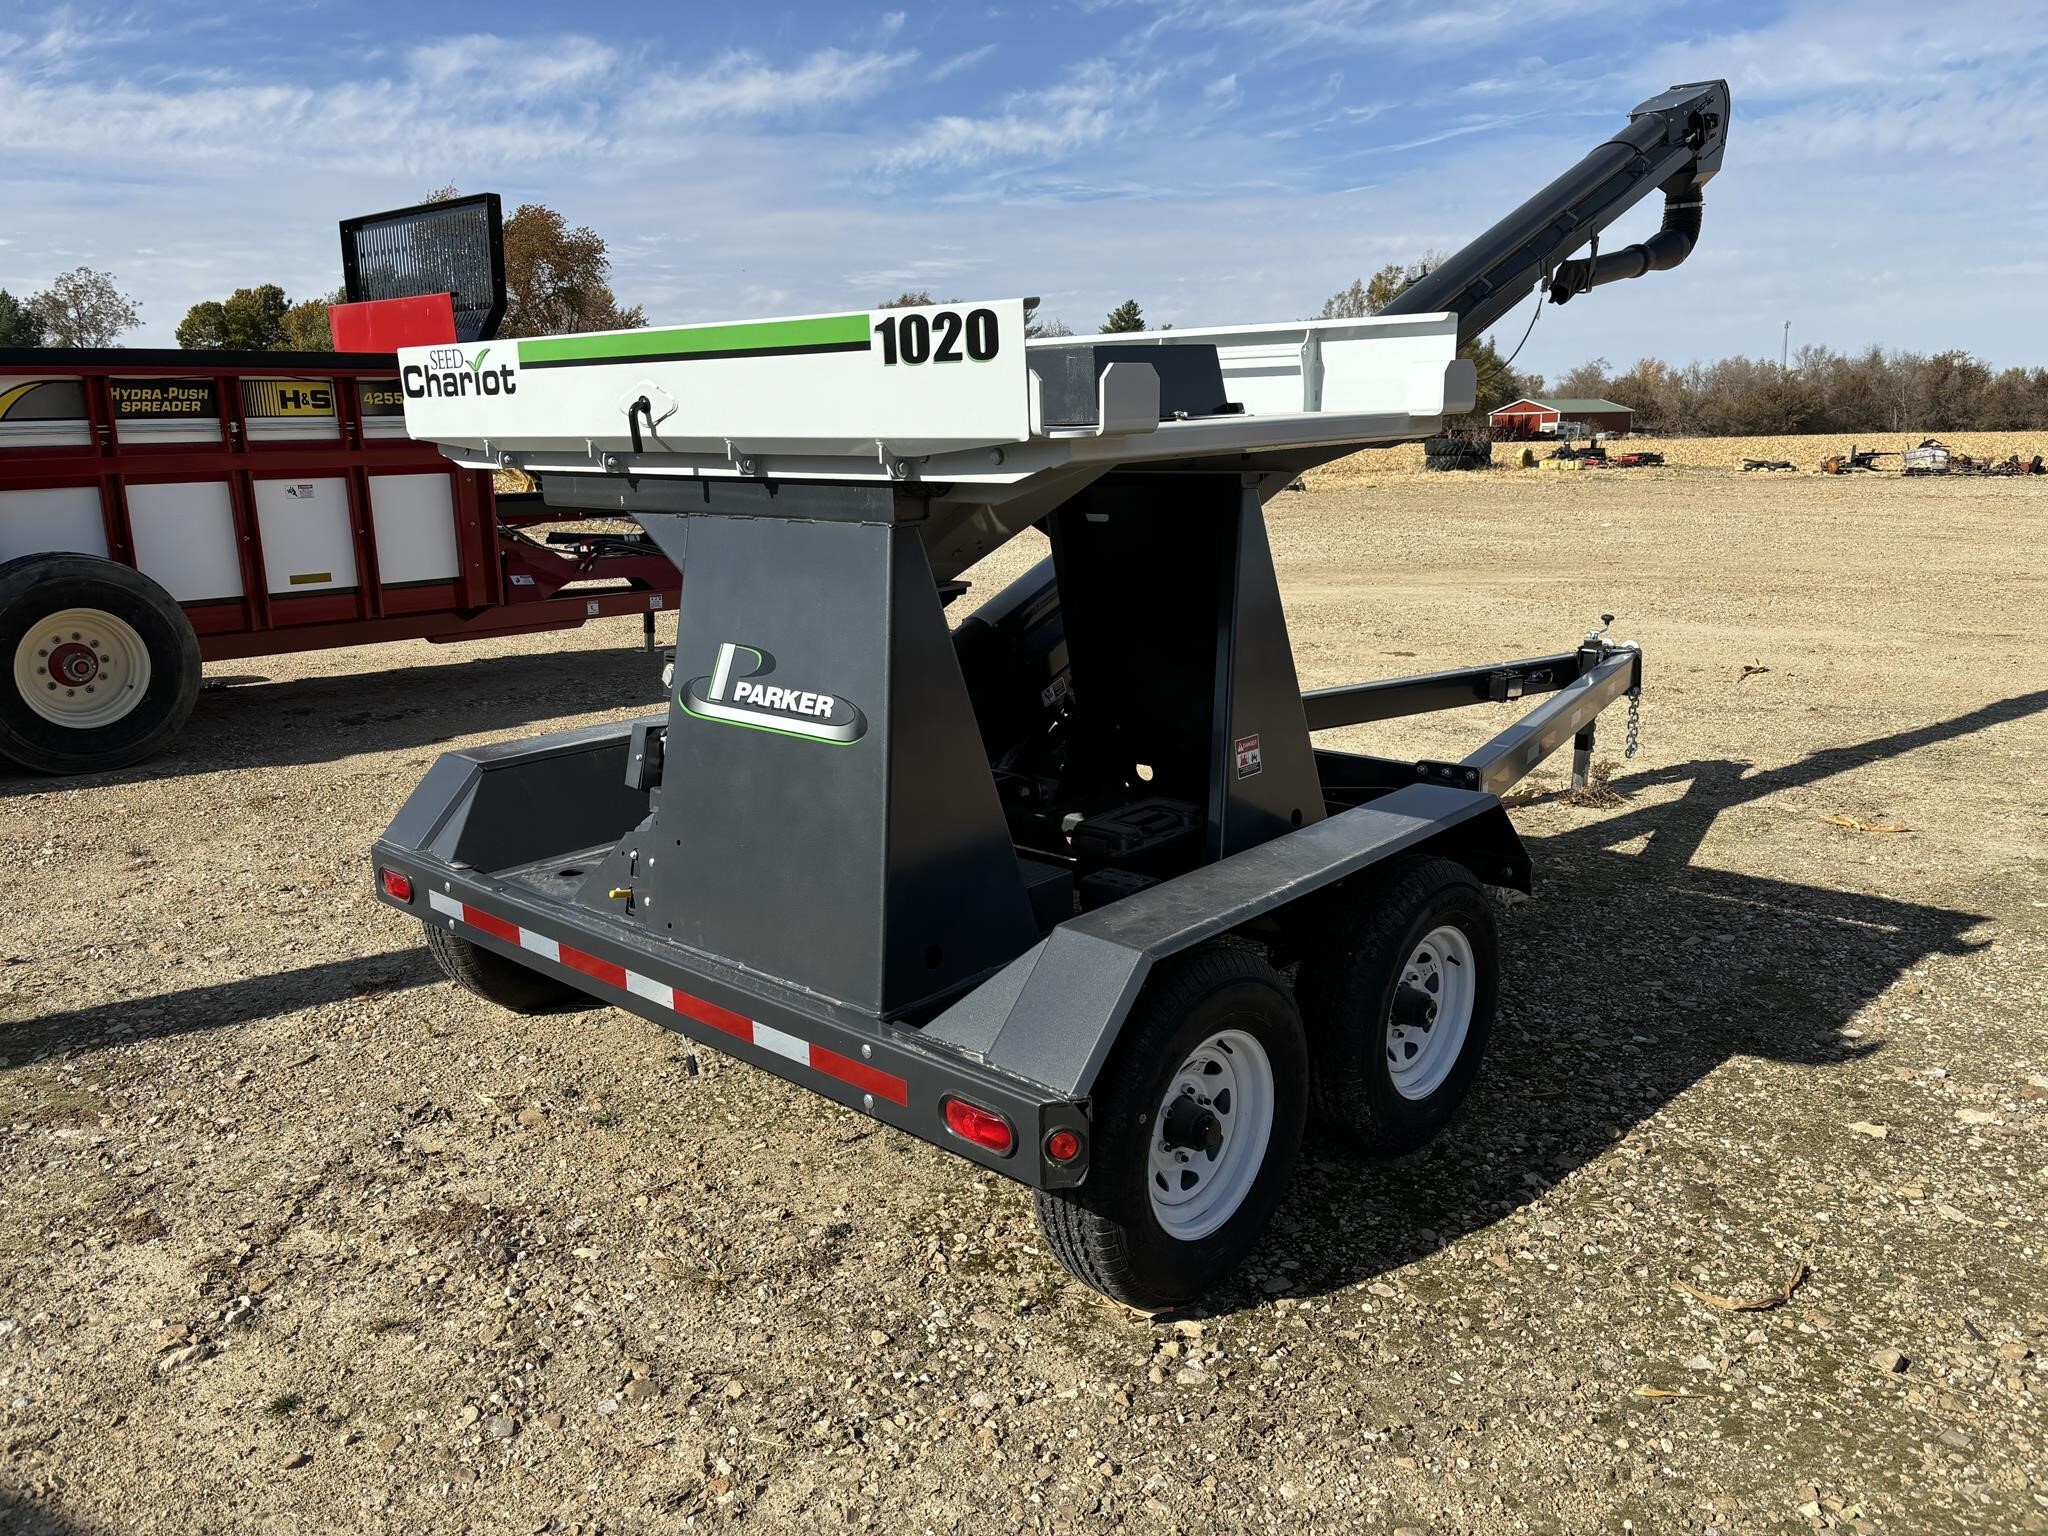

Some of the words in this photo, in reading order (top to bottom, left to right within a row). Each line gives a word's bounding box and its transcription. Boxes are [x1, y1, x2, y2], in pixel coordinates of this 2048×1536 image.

[874, 308, 1000, 367] 1020
[430, 348, 464, 370] SEED
[403, 364, 516, 398] Chariot
[110, 387, 208, 400] HYDRA-PUSH
[280, 389, 331, 409] H&S
[363, 392, 404, 405] 4255
[121, 401, 201, 412] SPREADER
[733, 681, 835, 718] PARKER
